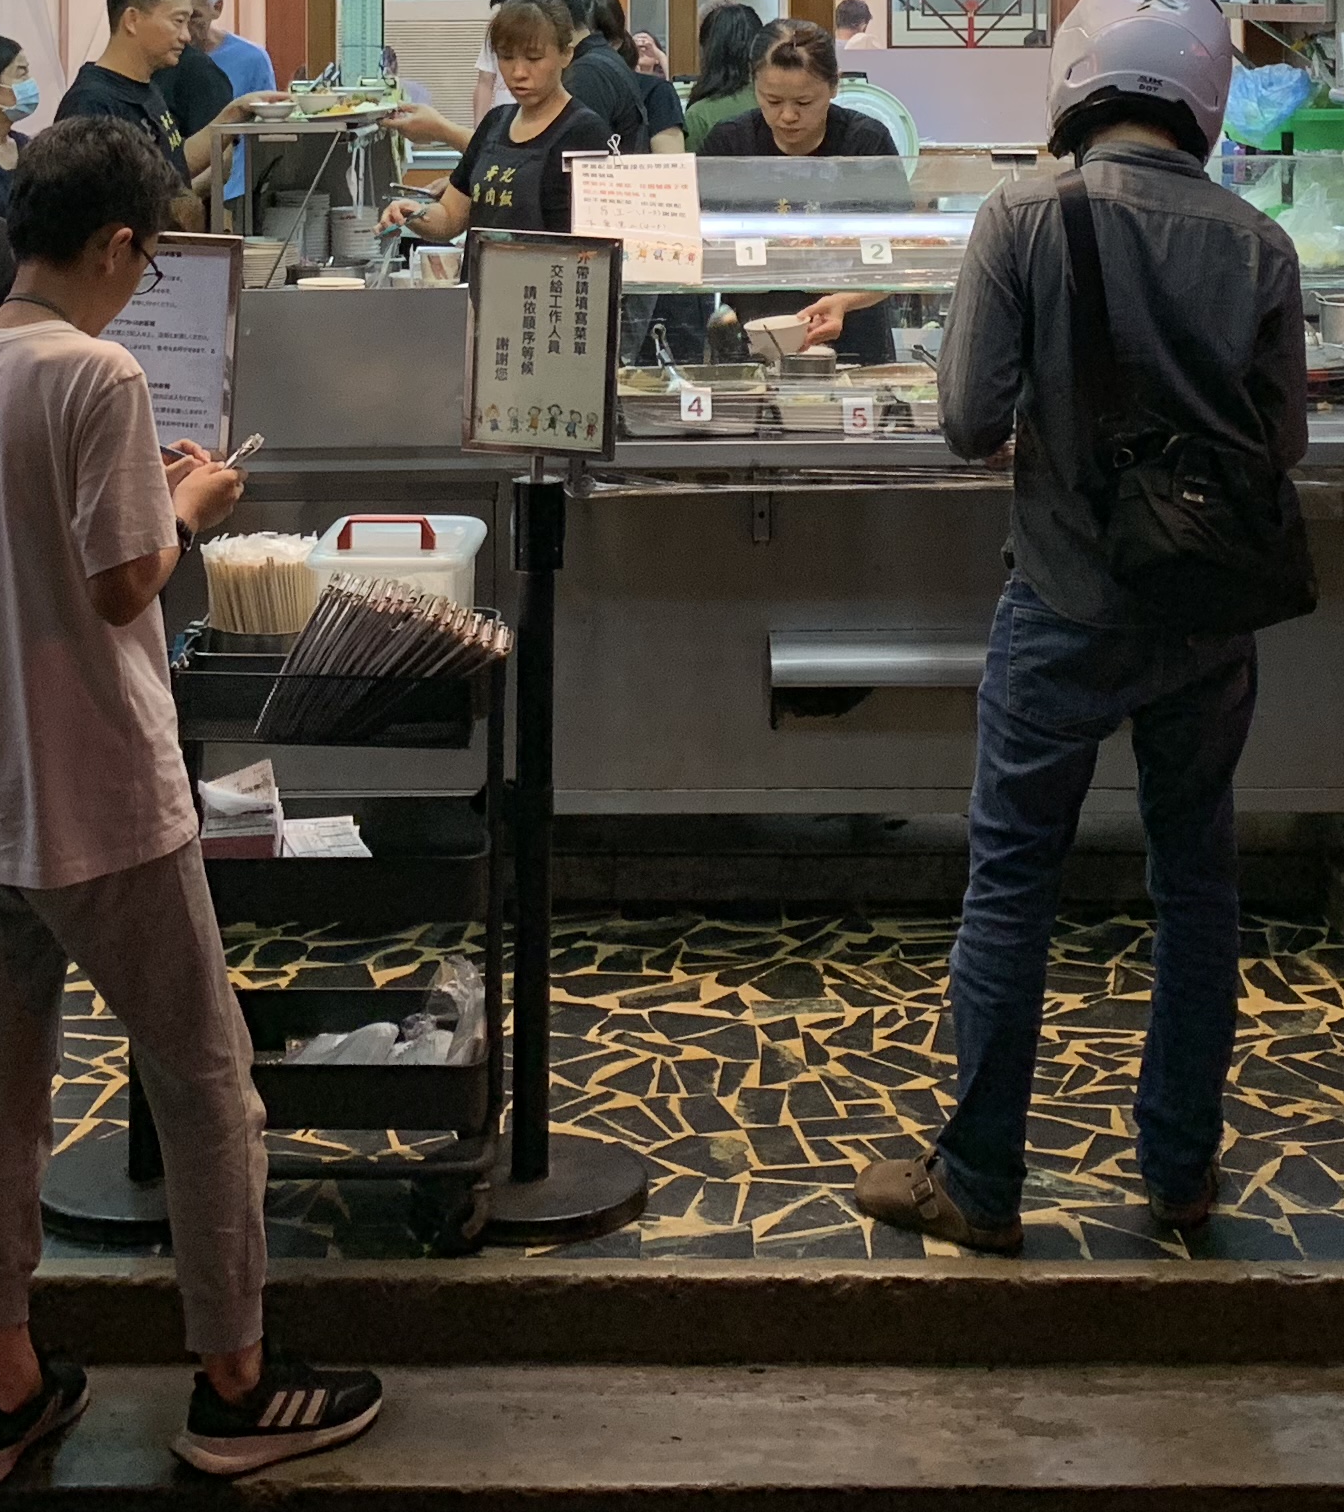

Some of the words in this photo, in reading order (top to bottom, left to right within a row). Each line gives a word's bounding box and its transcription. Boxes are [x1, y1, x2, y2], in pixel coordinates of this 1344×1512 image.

[745, 246, 754, 261] 1
[870, 243, 885, 259] 2
[548, 264, 564, 355] 交給工作人員
[521, 285, 537, 376] 請依順序等候
[494, 337, 509, 381] 謝謝您
[687, 396, 703, 417] 4
[852, 408, 867, 428] 5
